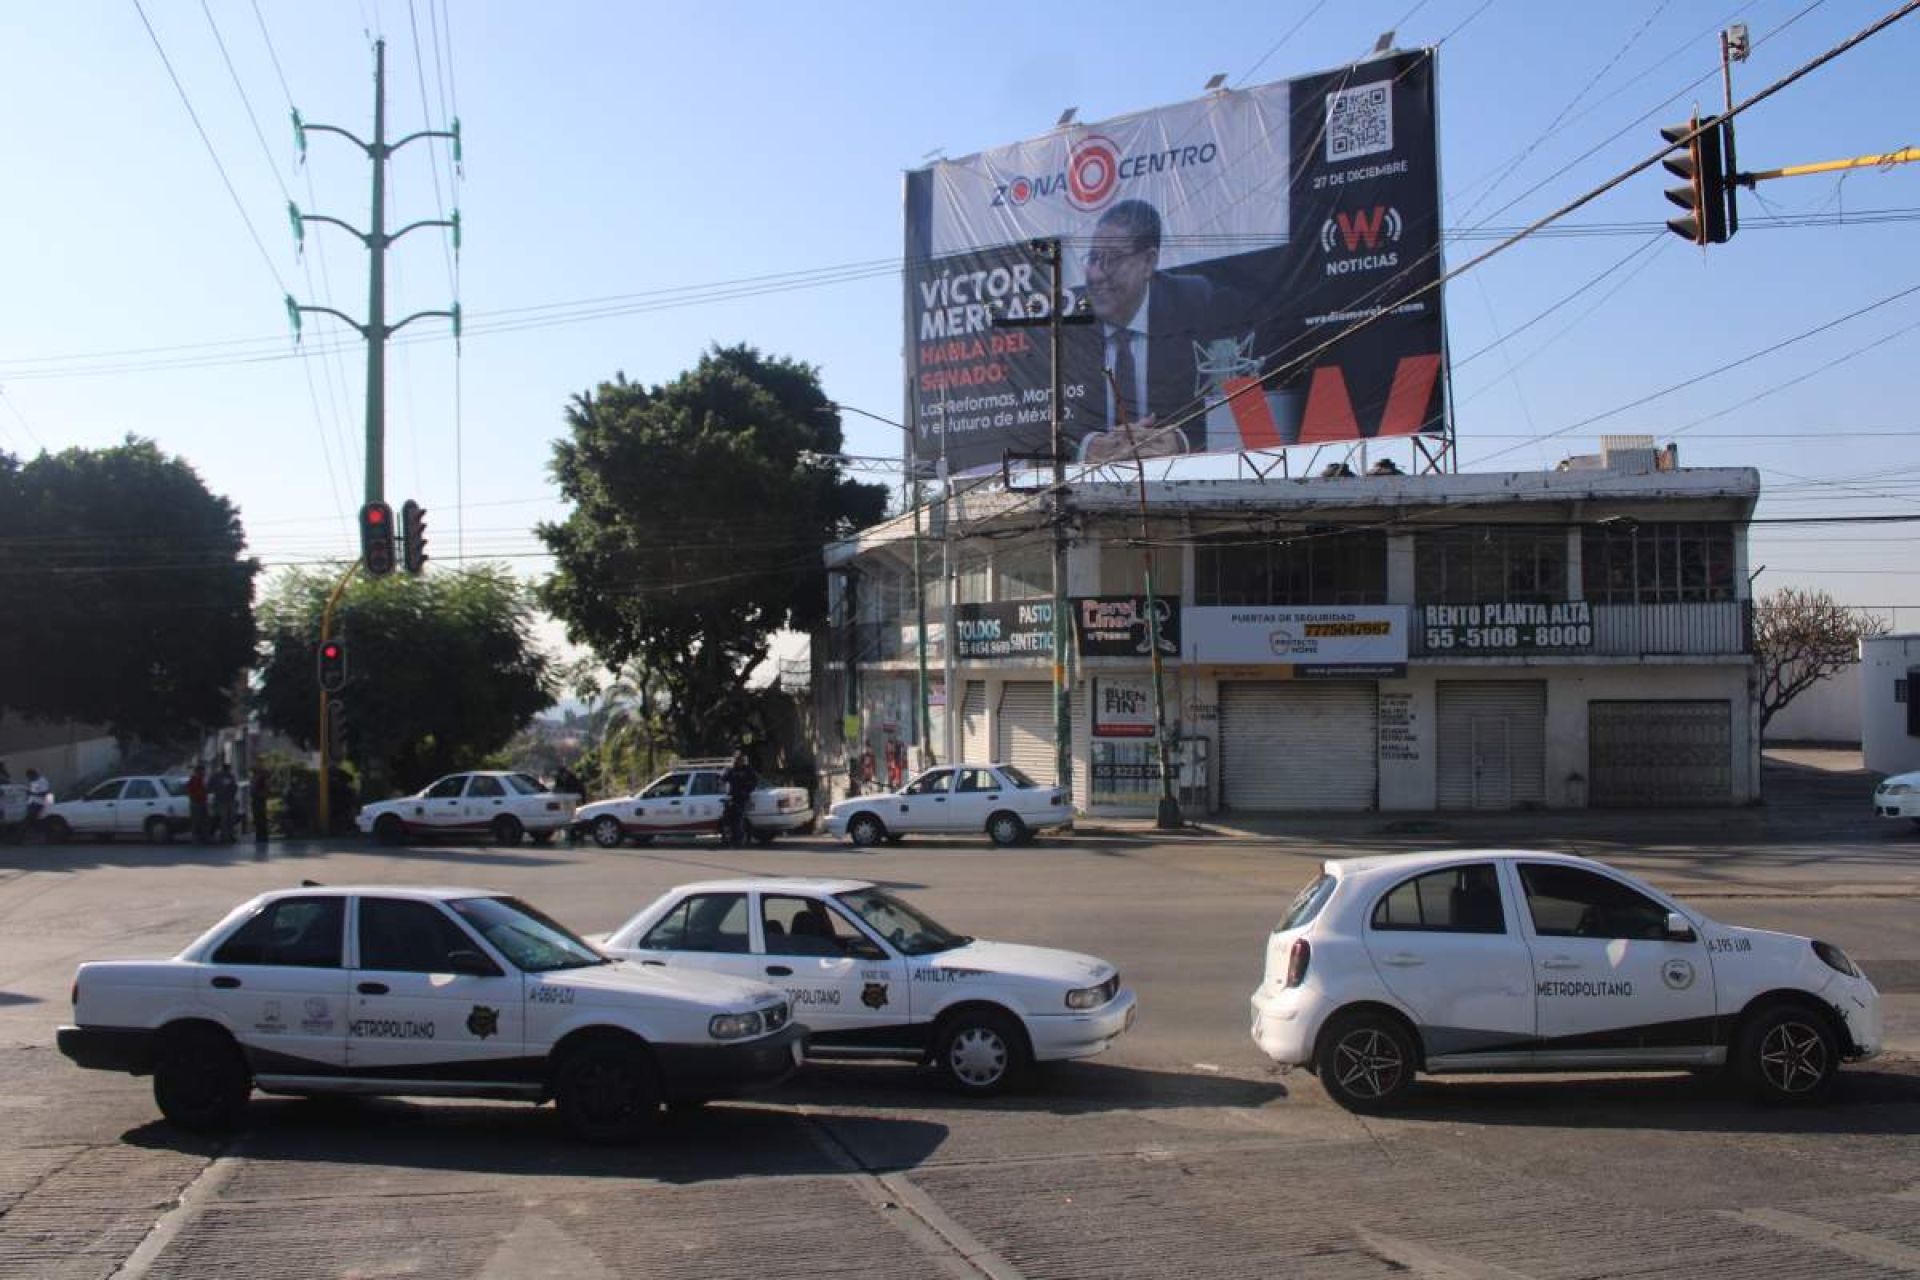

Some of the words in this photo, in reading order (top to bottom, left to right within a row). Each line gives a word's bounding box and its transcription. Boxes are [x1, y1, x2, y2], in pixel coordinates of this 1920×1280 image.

[991, 174, 1066, 206] ZONA
[1119, 143, 1217, 180] CENTRO
[1314, 174, 1327, 188] 27
[1330, 171, 1344, 185] DE
[1347, 160, 1408, 181] DICIEMBRE
[1336, 206, 1385, 251] W
[1326, 253, 1398, 275] NOTICIAS
[920, 263, 1032, 308] VÍCTOR
[921, 339, 985, 365] HABLA
[992, 332, 1030, 354] DEL
[1023, 383, 1085, 404] Morlos
[921, 422, 931, 438] y
[994, 409, 1014, 424] de
[1018, 405, 1074, 423] Méxio.
[1231, 613, 1275, 622] PUERTAS
[1278, 613, 1292, 621] DE
[1294, 613, 1356, 622] SEGURIDAD
[1426, 604, 1480, 626] RENTO
[1484, 603, 1547, 625] PLANTA
[1551, 601, 1590, 624] ALTA
[957, 619, 1000, 640] TOLDOS
[1010, 628, 1054, 651] SINTÉTIC
[1427, 628, 1455, 648] 55
[1535, 625, 1592, 646] 8000
[1105, 687, 1147, 701] BUEN
[1106, 700, 1136, 714] FIN
[1537, 981, 1633, 997] METROPOLITANO
[348, 1019, 436, 1039] METROPOLITANO
